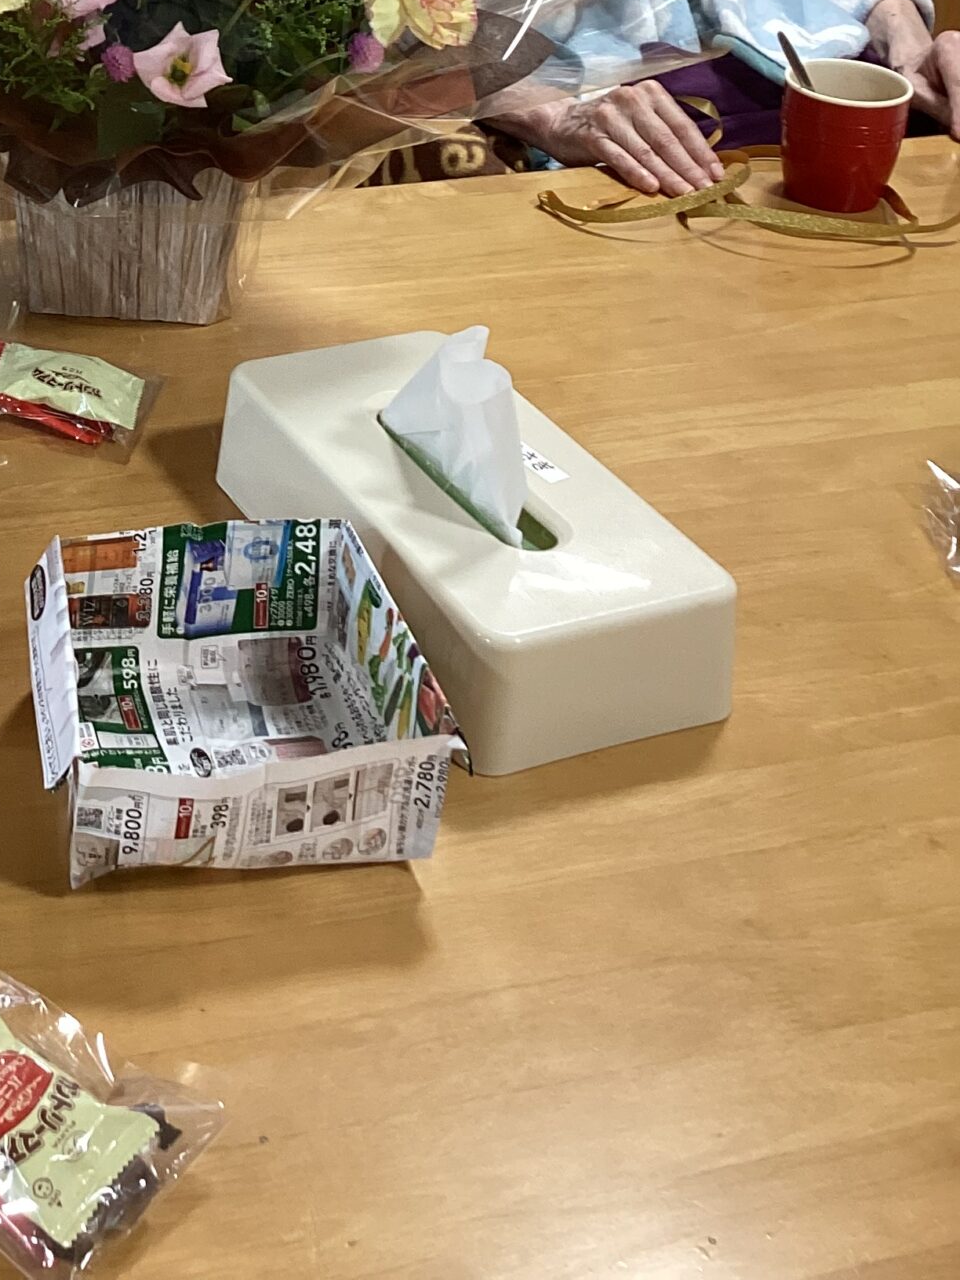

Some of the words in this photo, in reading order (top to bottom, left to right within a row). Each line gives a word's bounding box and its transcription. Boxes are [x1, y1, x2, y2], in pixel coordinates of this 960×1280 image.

[31, 365, 103, 399] カントリーマアム
[294, 519, 318, 589] 各2,48
[161, 549, 180, 636] 手軽に栄養補給
[121, 648, 139, 690] 598円
[147, 658, 180, 747] 素肌と同じ弱酸性に
[165, 686, 194, 743] こだわりました
[0, 1075, 81, 1170] カントリーマア
